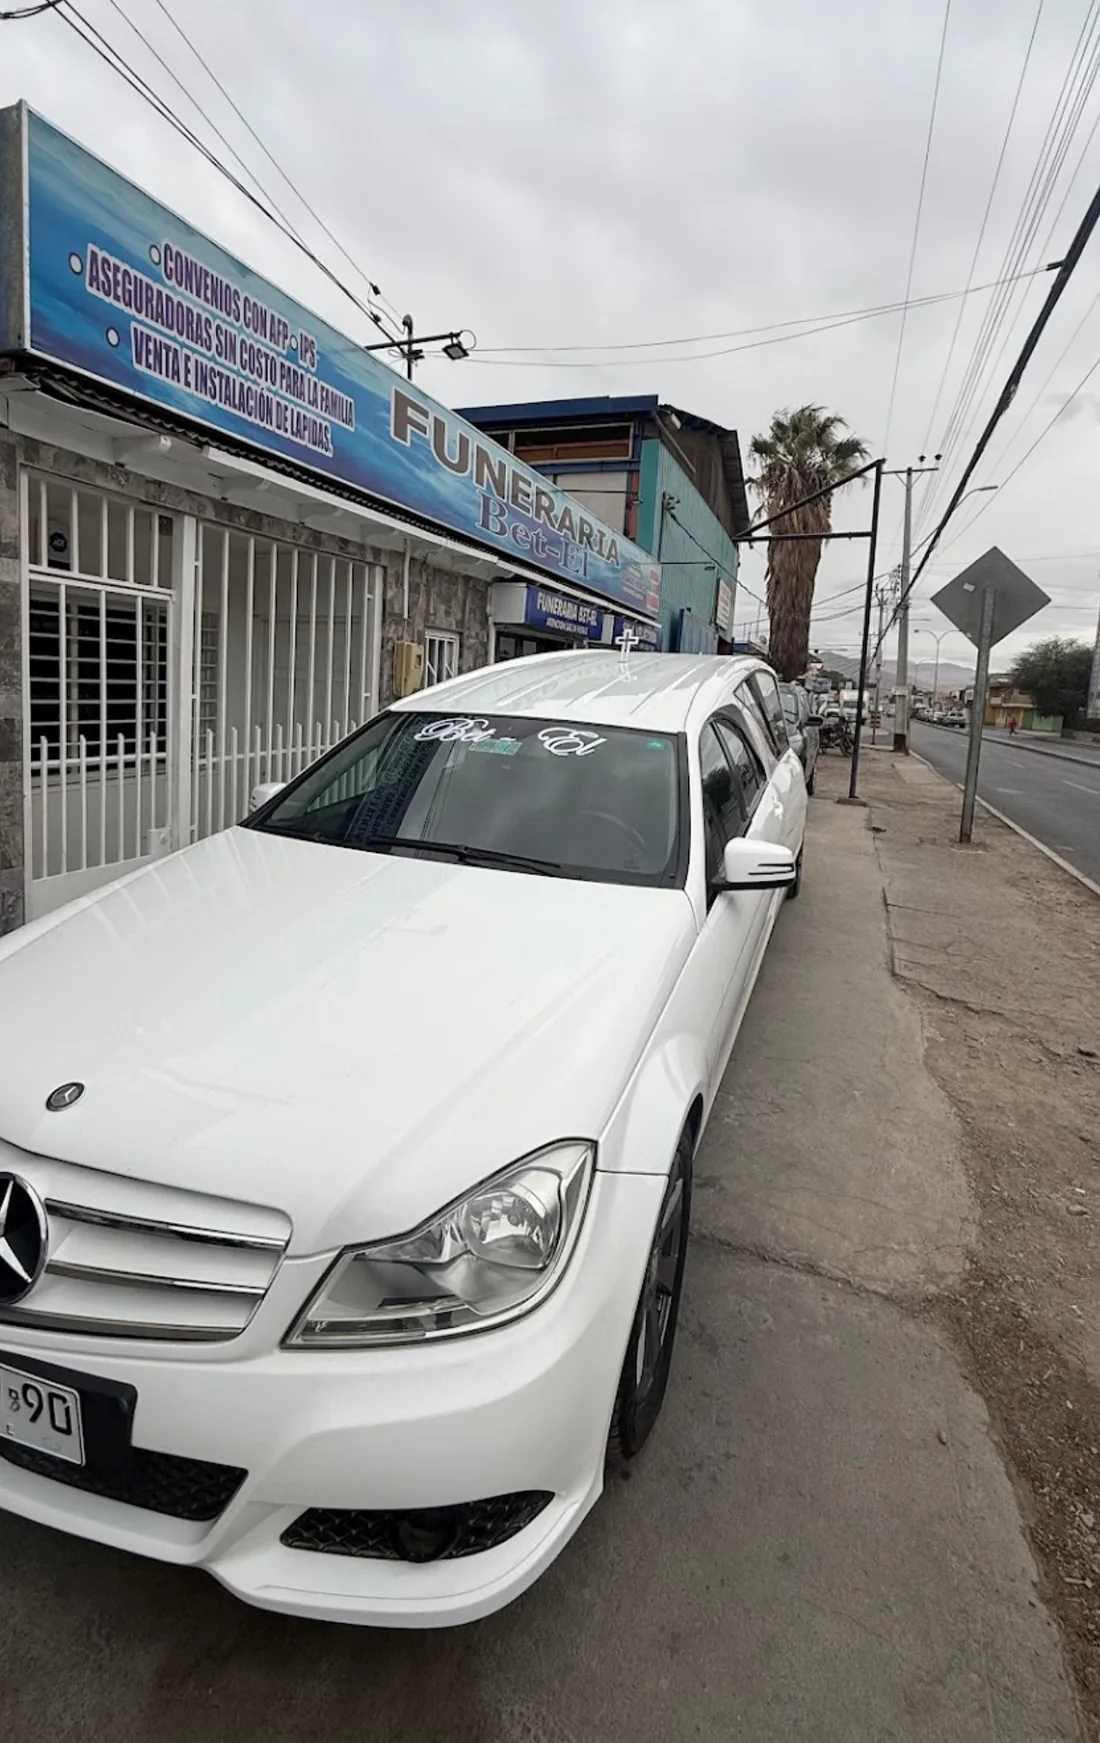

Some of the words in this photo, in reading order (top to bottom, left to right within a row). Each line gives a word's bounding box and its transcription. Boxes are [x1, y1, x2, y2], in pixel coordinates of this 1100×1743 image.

[87, 248, 213, 353] ASEGURADORAS
[215, 323, 237, 365] SIN
[240, 338, 277, 387] COSTO
[280, 360, 306, 404] PARA
[307, 376, 319, 410] LA
[320, 381, 354, 427] FAMILIA
[163, 243, 241, 322] CONVENIOS
[243, 295, 267, 339] CON
[269, 313, 289, 350] AFP
[300, 332, 316, 368] IPS
[132, 326, 180, 386] VENTA
[184, 353, 192, 387] E
[195, 360, 273, 427] INSTALACIÓN
[276, 400, 289, 433] DE
[391, 387, 621, 567] FUNERARIA
[475, 490, 591, 579] Bet-El
[537, 592, 578, 621] FUNERARIA
